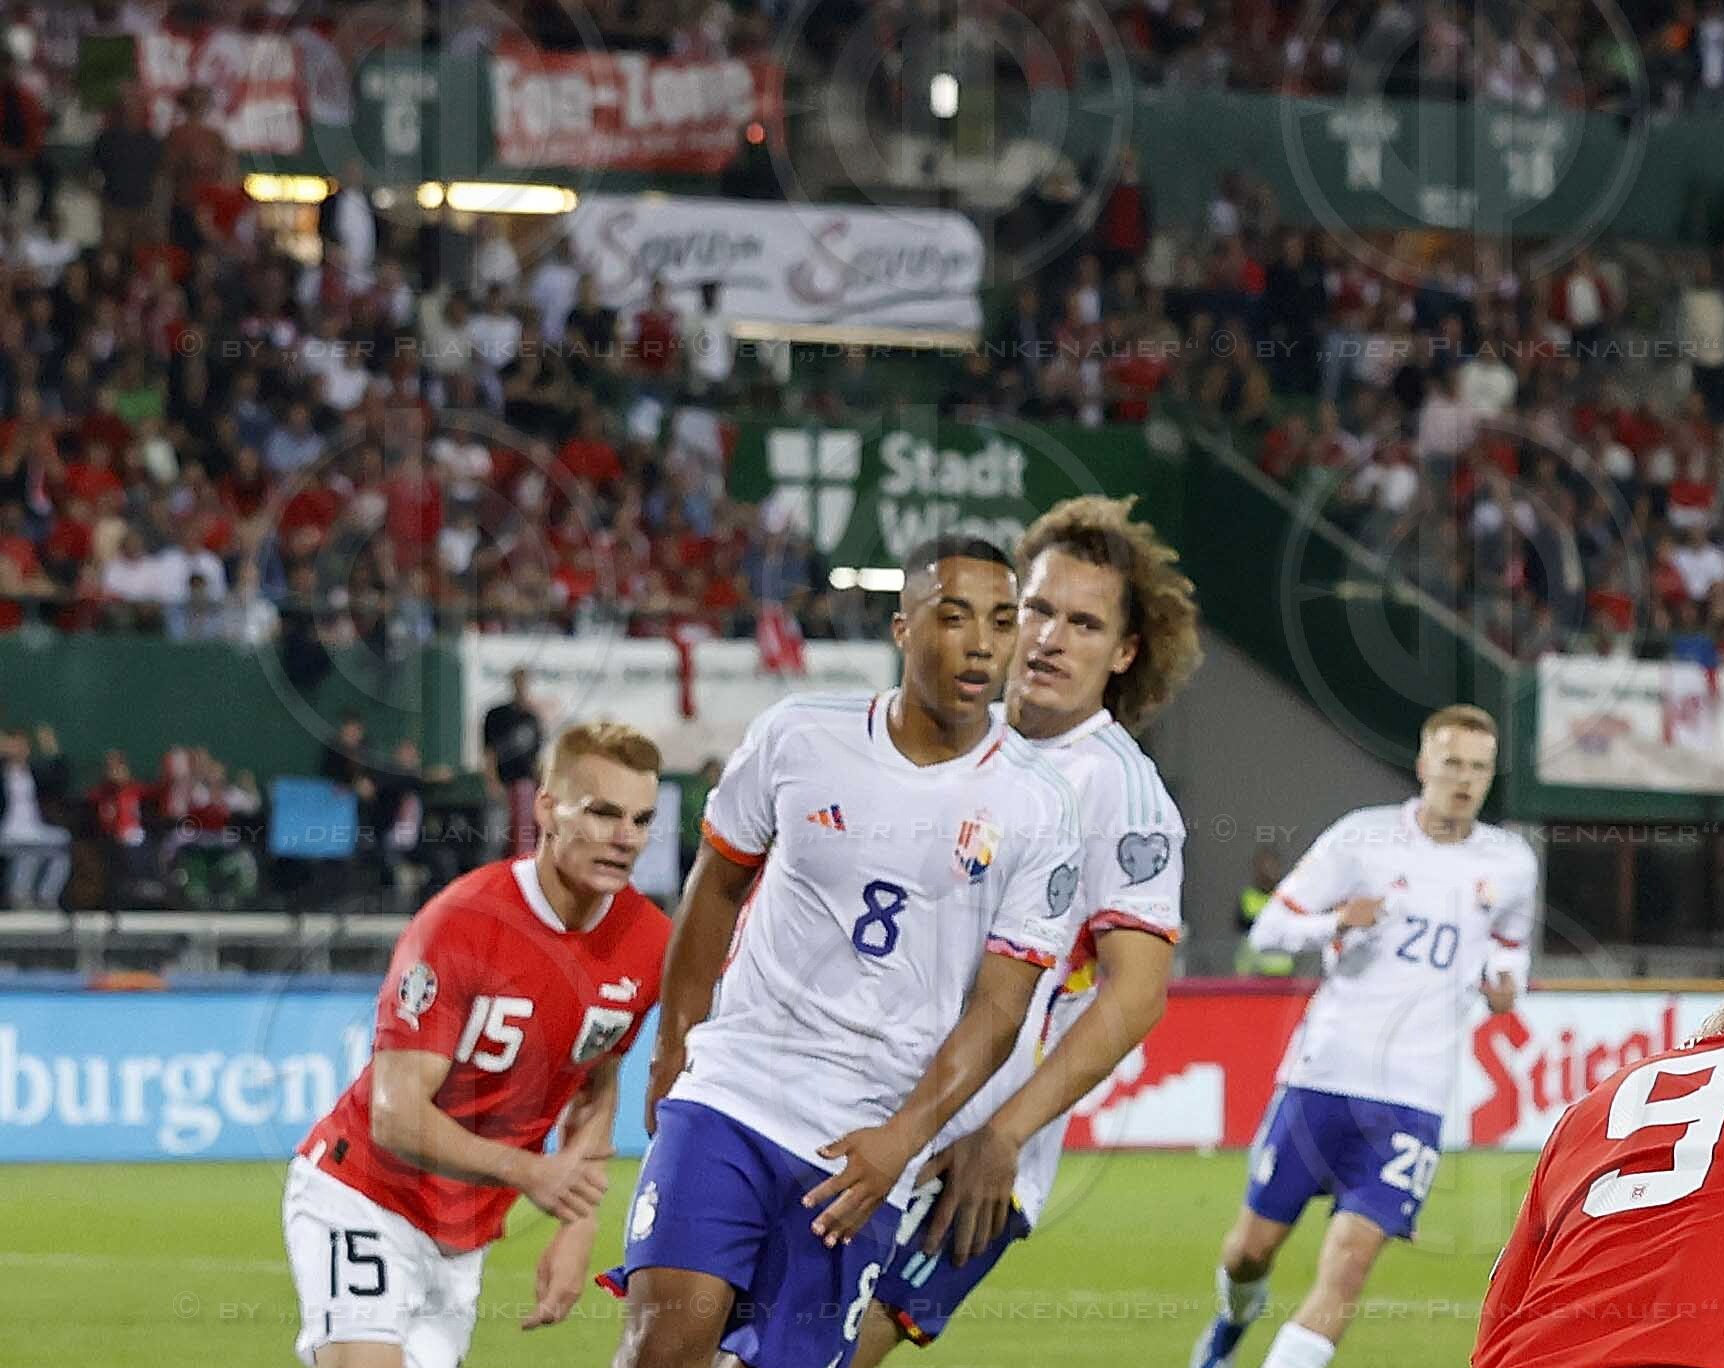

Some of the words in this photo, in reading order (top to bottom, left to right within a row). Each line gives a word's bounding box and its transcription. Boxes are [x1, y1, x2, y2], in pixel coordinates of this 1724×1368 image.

[879, 431, 1027, 497] Stadt
[852, 879, 908, 957] 8
[1396, 916, 1459, 970] 20
[453, 994, 534, 1073] 15
[1380, 1131, 1441, 1201] 20
[330, 1228, 386, 1298] 15
